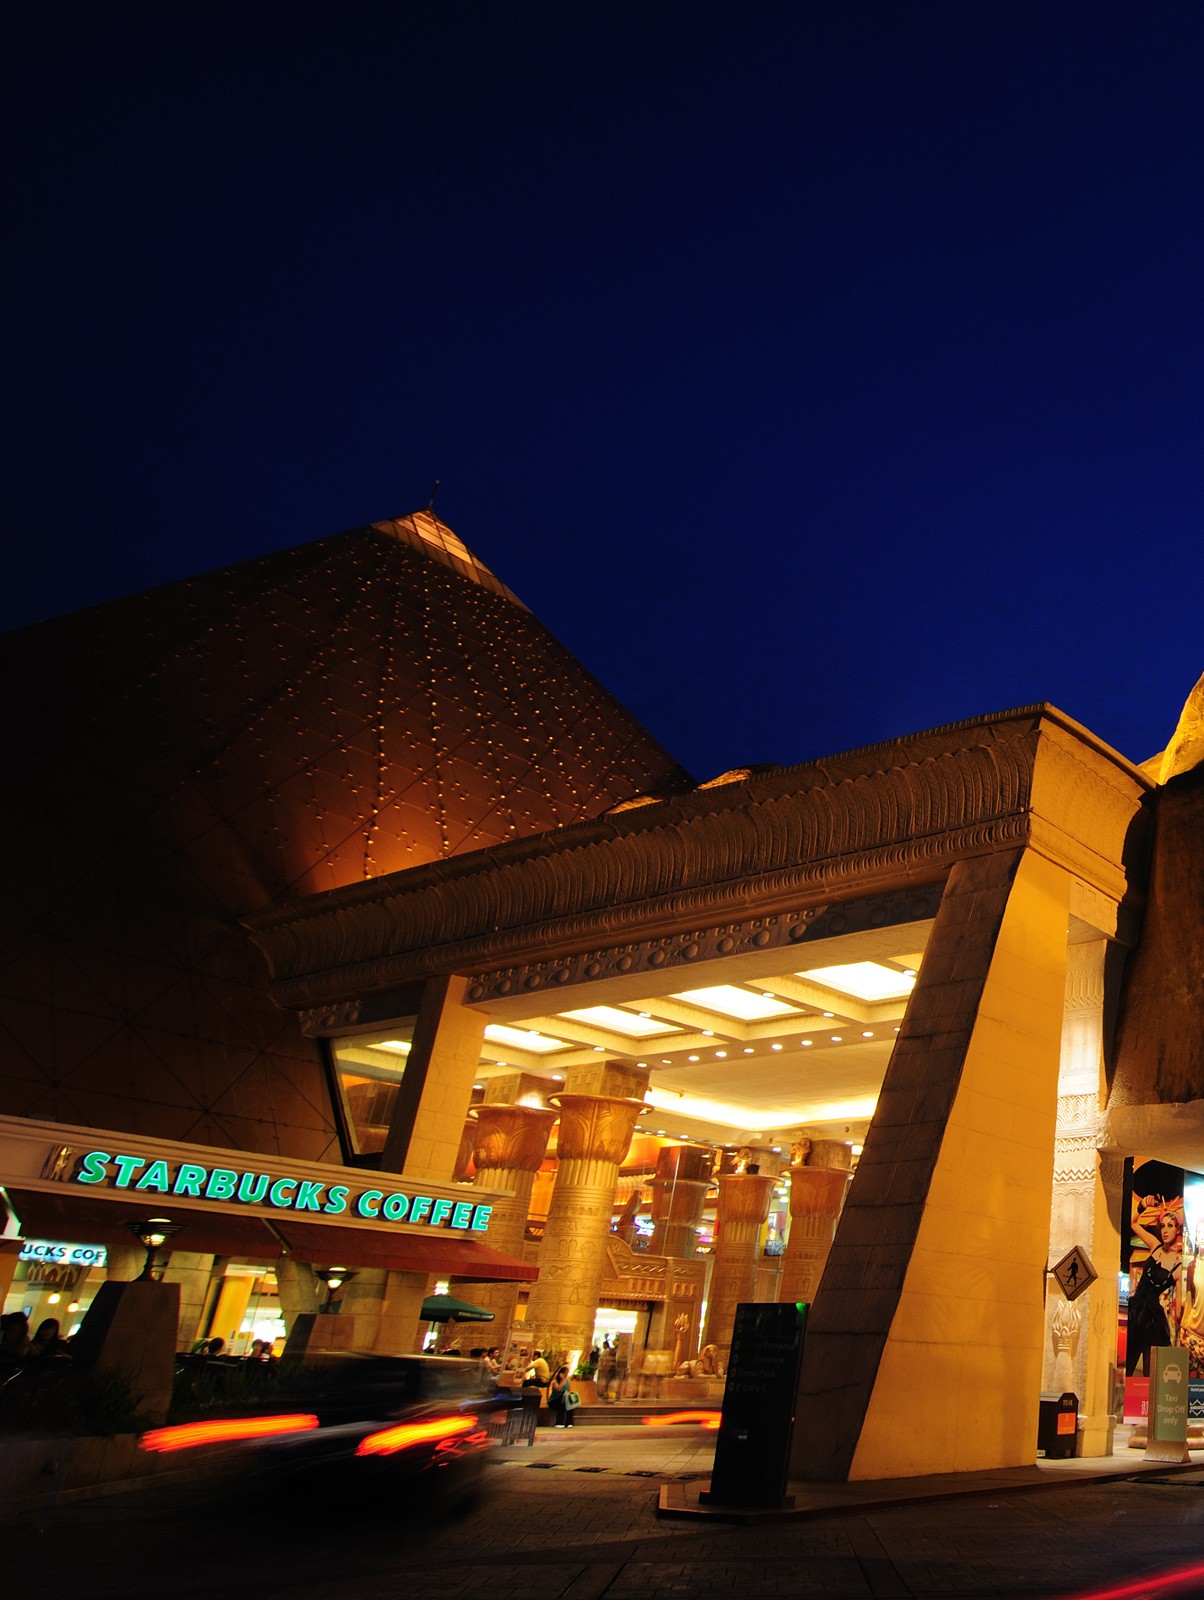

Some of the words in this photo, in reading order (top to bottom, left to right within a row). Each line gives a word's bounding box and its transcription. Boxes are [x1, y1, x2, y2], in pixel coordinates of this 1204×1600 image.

[77, 1151, 350, 1214] STARBUCKS
[357, 1189, 493, 1232] COFFEE
[1165, 1394, 1178, 1402] Taxi
[1157, 1404, 1174, 1414] Drop
[1175, 1404, 1185, 1413] Off
[1163, 1417, 1178, 1426] only
